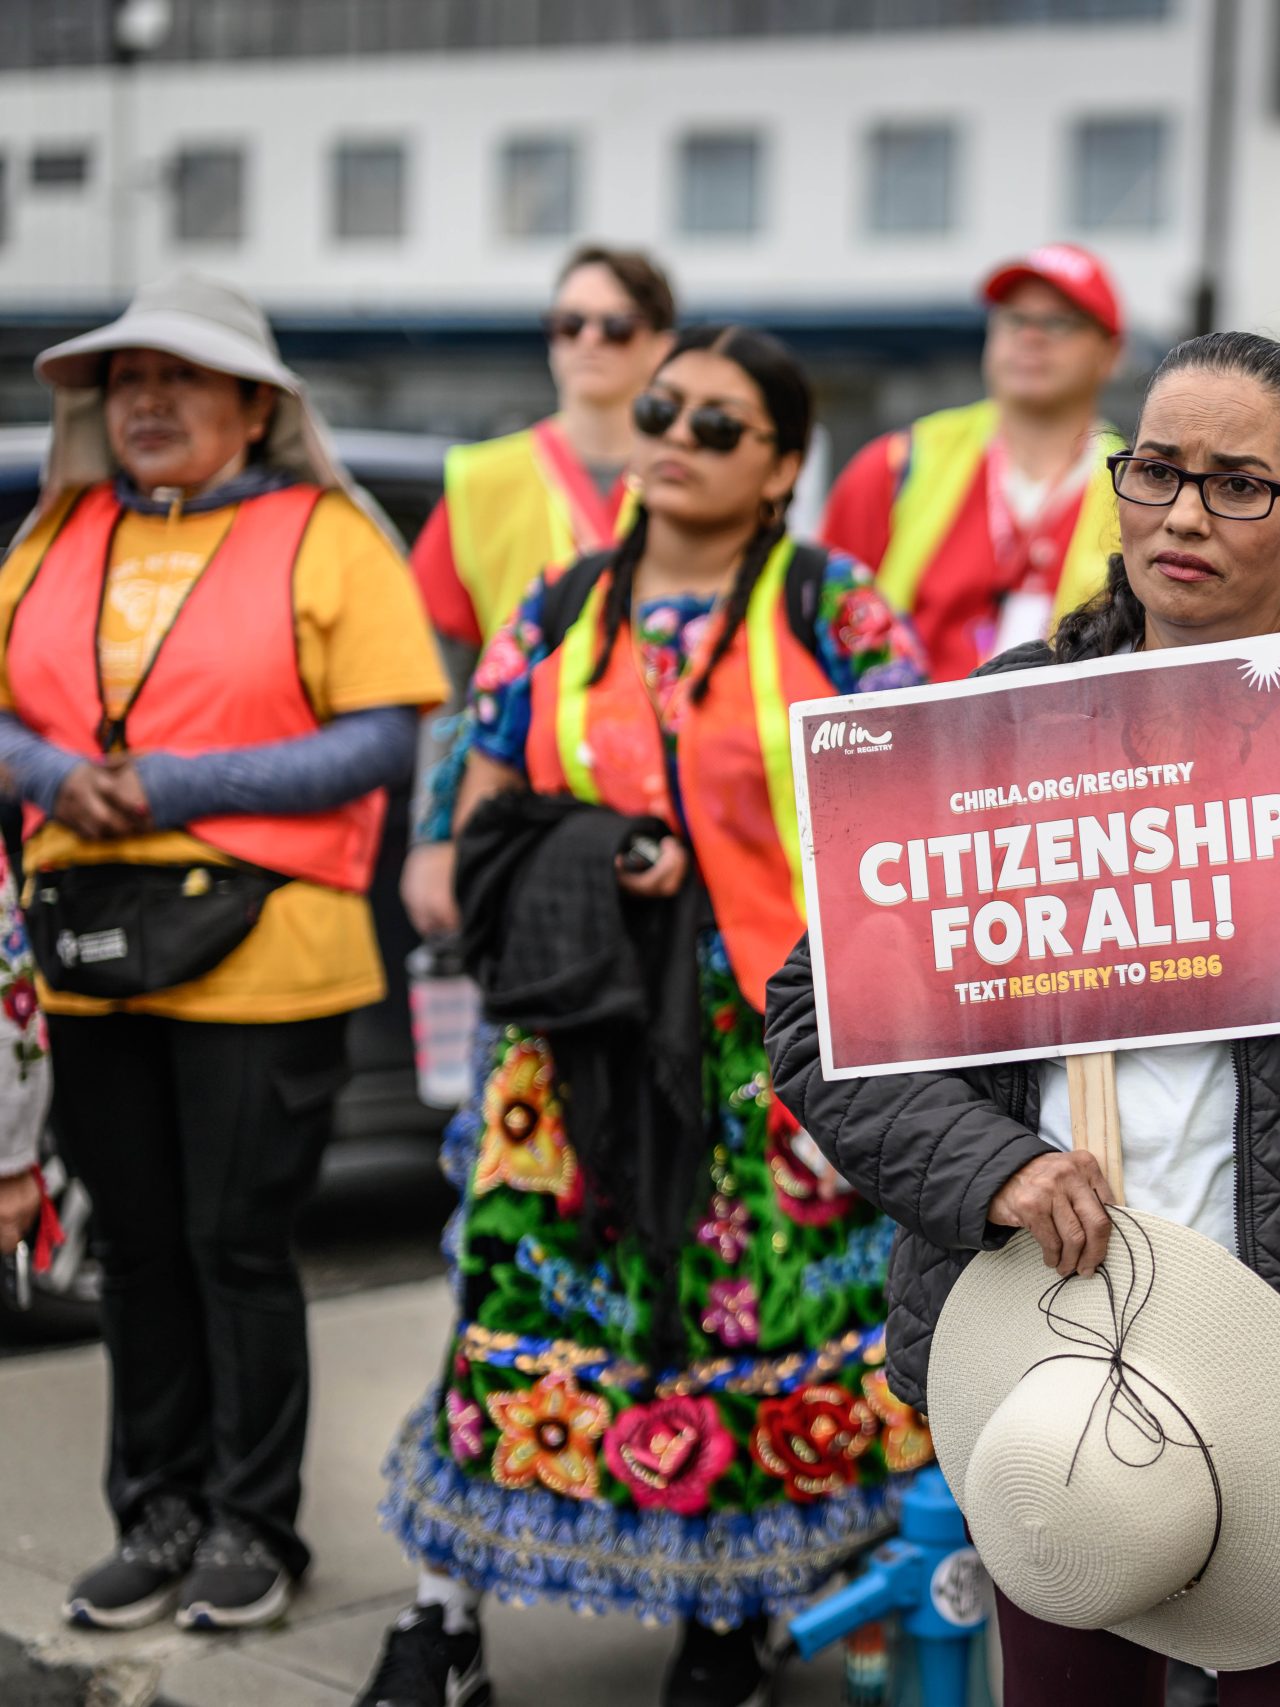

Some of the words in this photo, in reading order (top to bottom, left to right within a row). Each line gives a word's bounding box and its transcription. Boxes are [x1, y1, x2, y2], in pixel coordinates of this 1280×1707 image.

[811, 720, 846, 754] All
[849, 721, 893, 745] in
[857, 743, 893, 754] REGISTRY
[950, 761, 1195, 815] CHIRLA.ORG/REGISTRY
[930, 885, 1074, 972] FOR
[1081, 874, 1236, 955] ALL!
[954, 977, 1007, 1005] TEXT
[1008, 965, 1114, 1001] REGISTRY
[1114, 961, 1147, 986] TO
[1149, 954, 1223, 985] 52886
